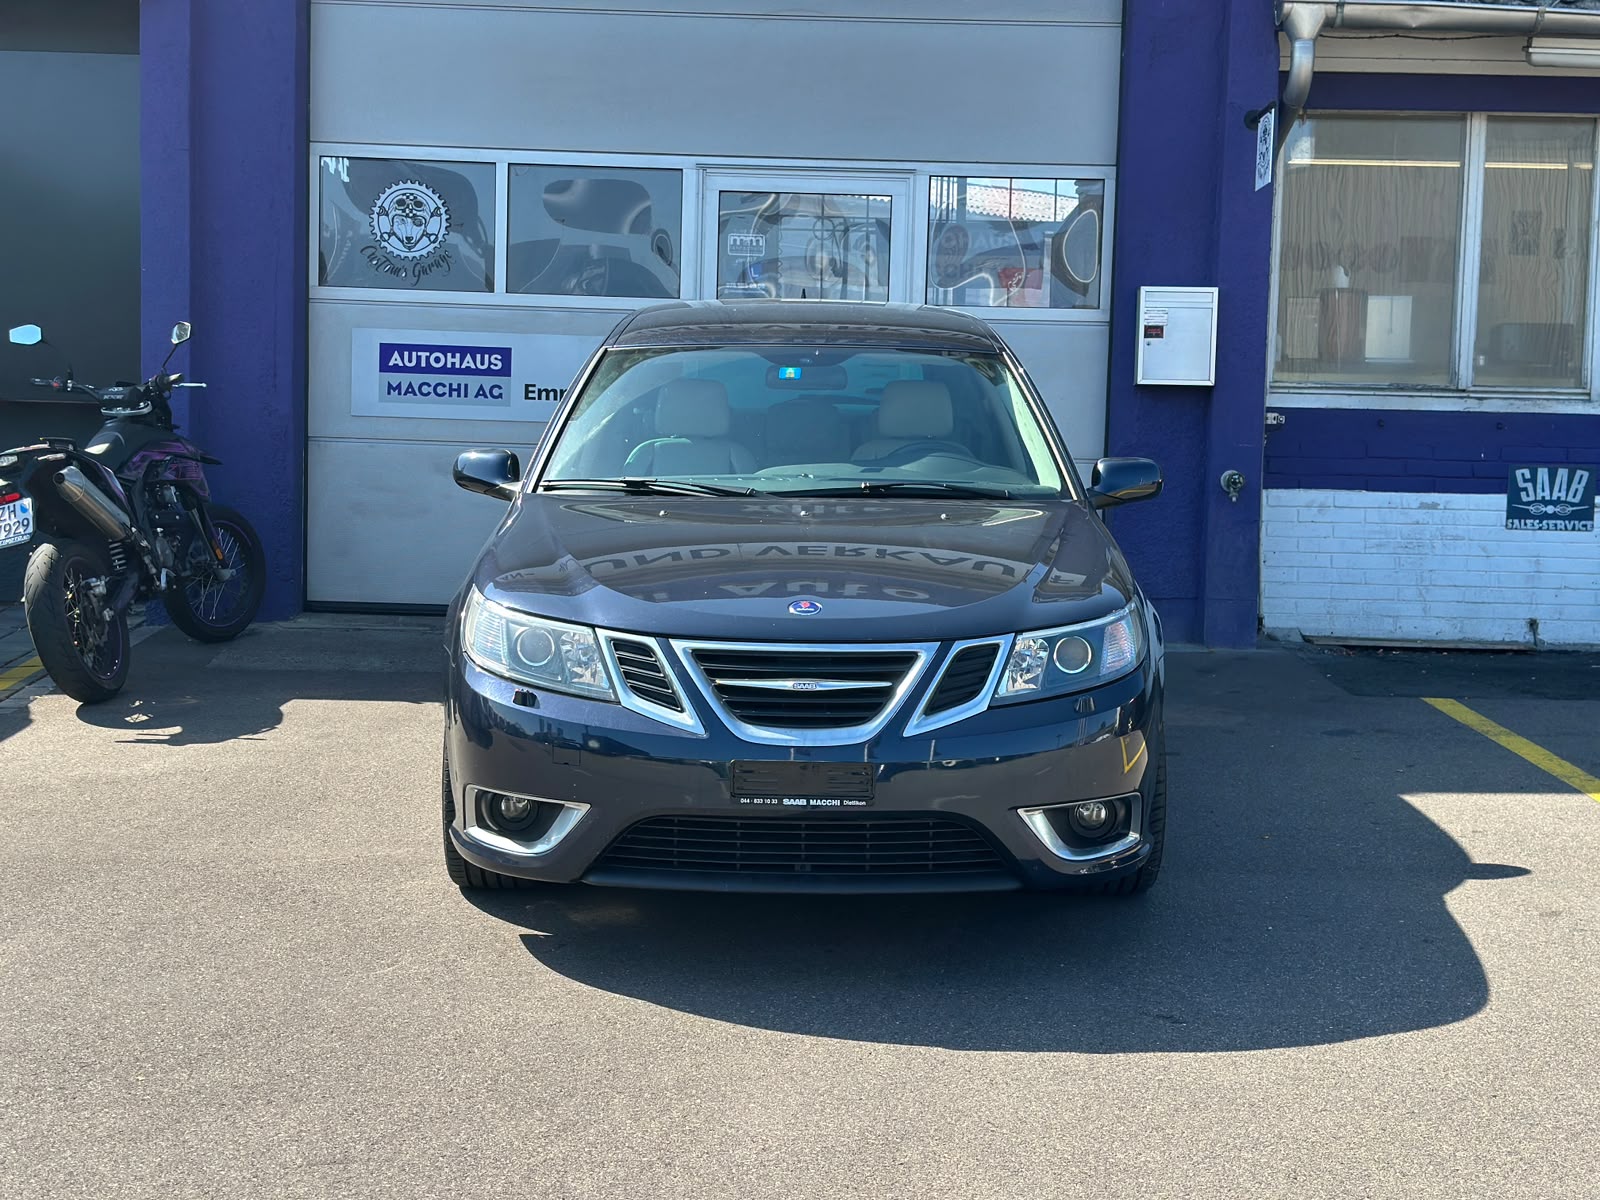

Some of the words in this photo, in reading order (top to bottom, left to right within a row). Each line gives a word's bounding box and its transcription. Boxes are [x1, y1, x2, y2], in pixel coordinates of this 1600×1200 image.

[410, 250, 457, 287] Garage
[388, 350, 503, 370] AUTOHAUS
[386, 380, 469, 399] MACCHI
[474, 383, 504, 400] AG
[1515, 467, 1590, 504] SAAB
[0, 504, 17, 521] ZH
[782, 798, 807, 806] SAAB
